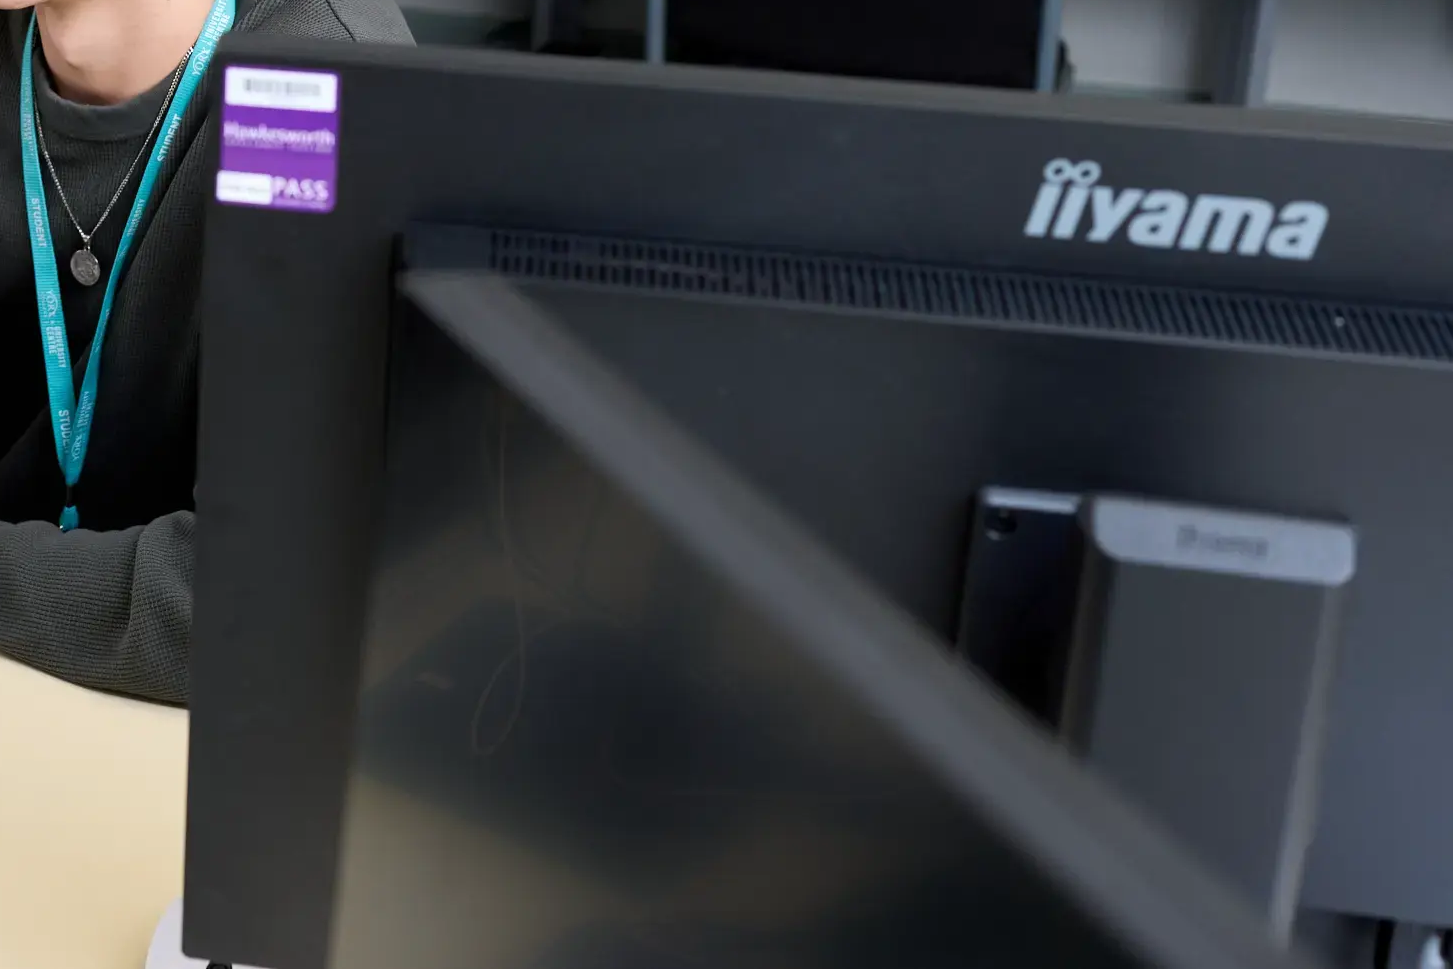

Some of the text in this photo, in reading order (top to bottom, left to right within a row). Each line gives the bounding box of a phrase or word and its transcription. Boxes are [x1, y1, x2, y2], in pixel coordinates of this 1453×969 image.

[212, 13, 230, 41] CENTRE
[192, 47, 210, 75] YORK
[157, 113, 183, 163] STUDENT
[272, 175, 328, 202] PASS
[31, 198, 47, 247] STUDENT
[1023, 158, 1330, 261] iiyama
[46, 327, 57, 354] CENTRE
[54, 326, 66, 367] UNIVERSITY
[58, 409, 72, 453] STUDE
